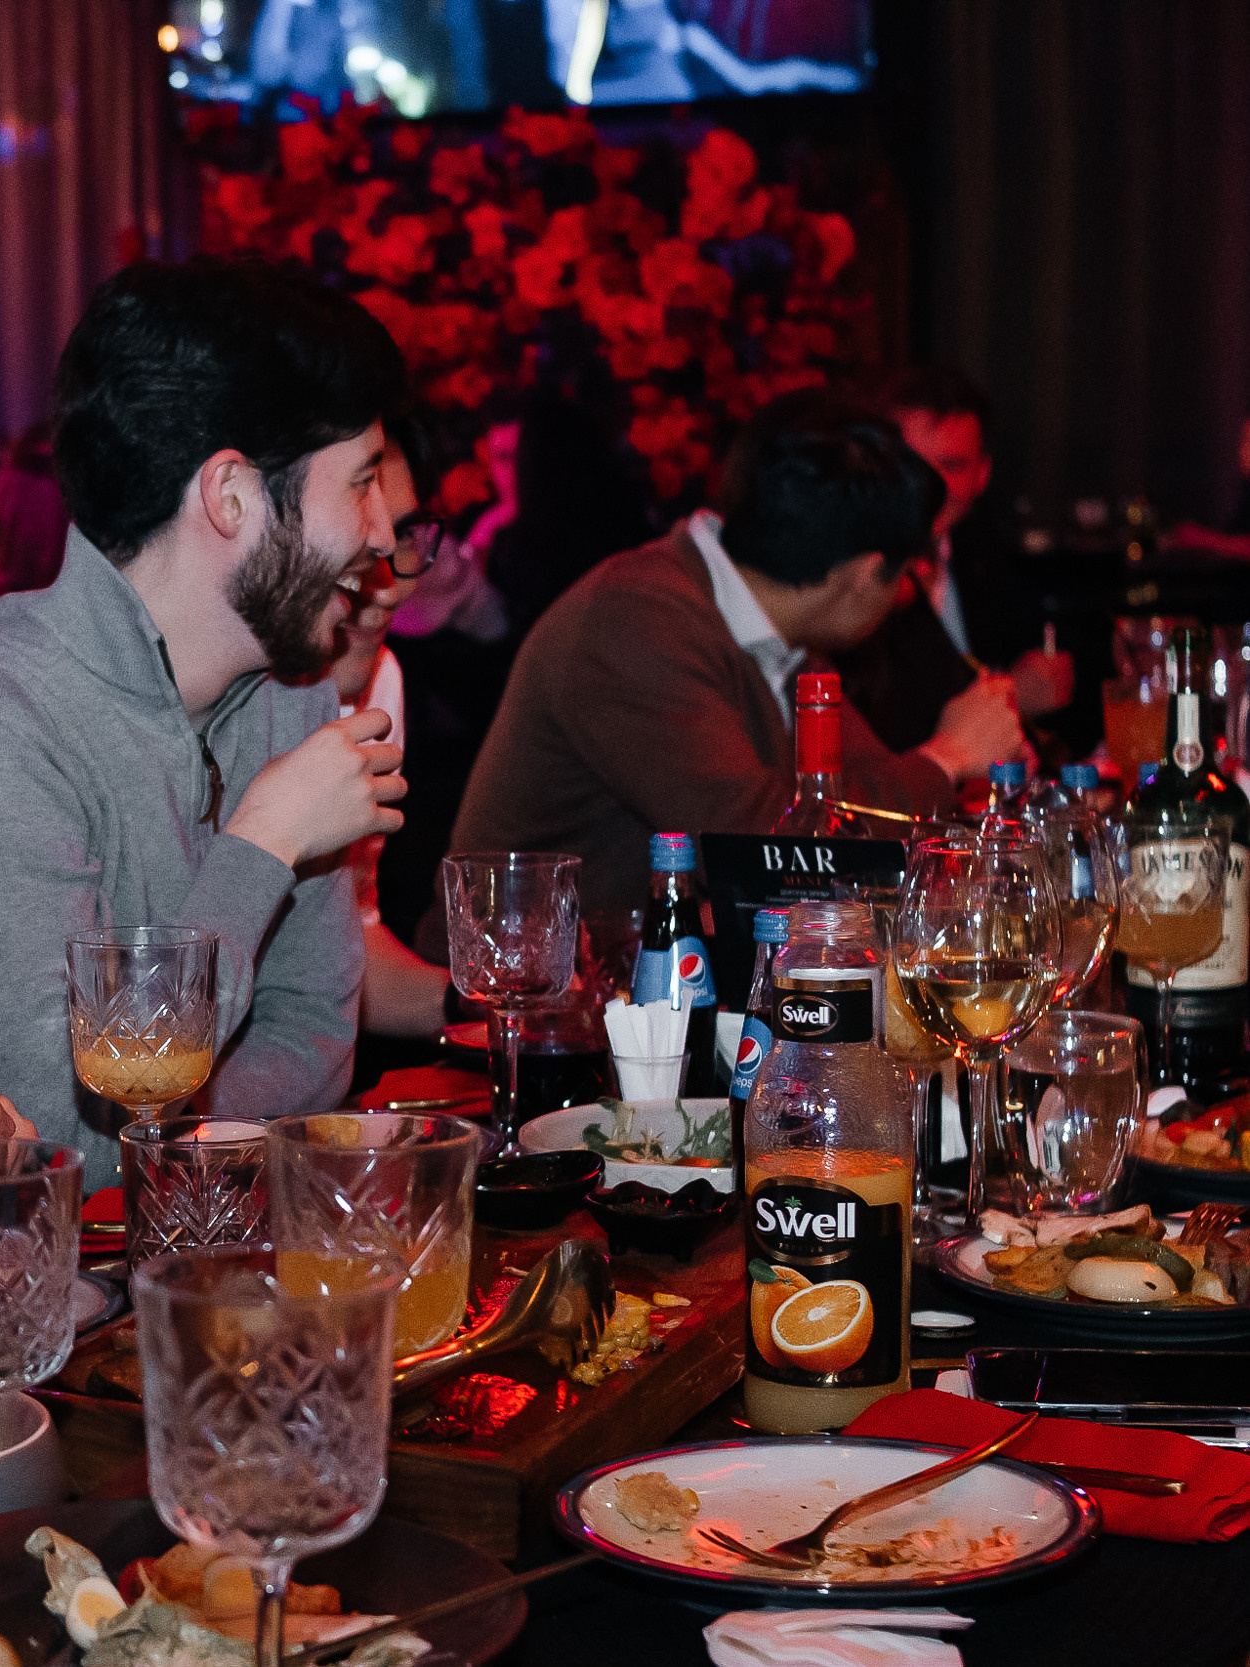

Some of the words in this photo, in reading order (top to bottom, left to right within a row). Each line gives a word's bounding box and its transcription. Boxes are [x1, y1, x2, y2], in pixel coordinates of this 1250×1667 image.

[762, 844, 836, 873] BAR
[782, 1004, 829, 1024] Swell
[733, 1076, 756, 1089] eps
[755, 1197, 856, 1239] Swell
